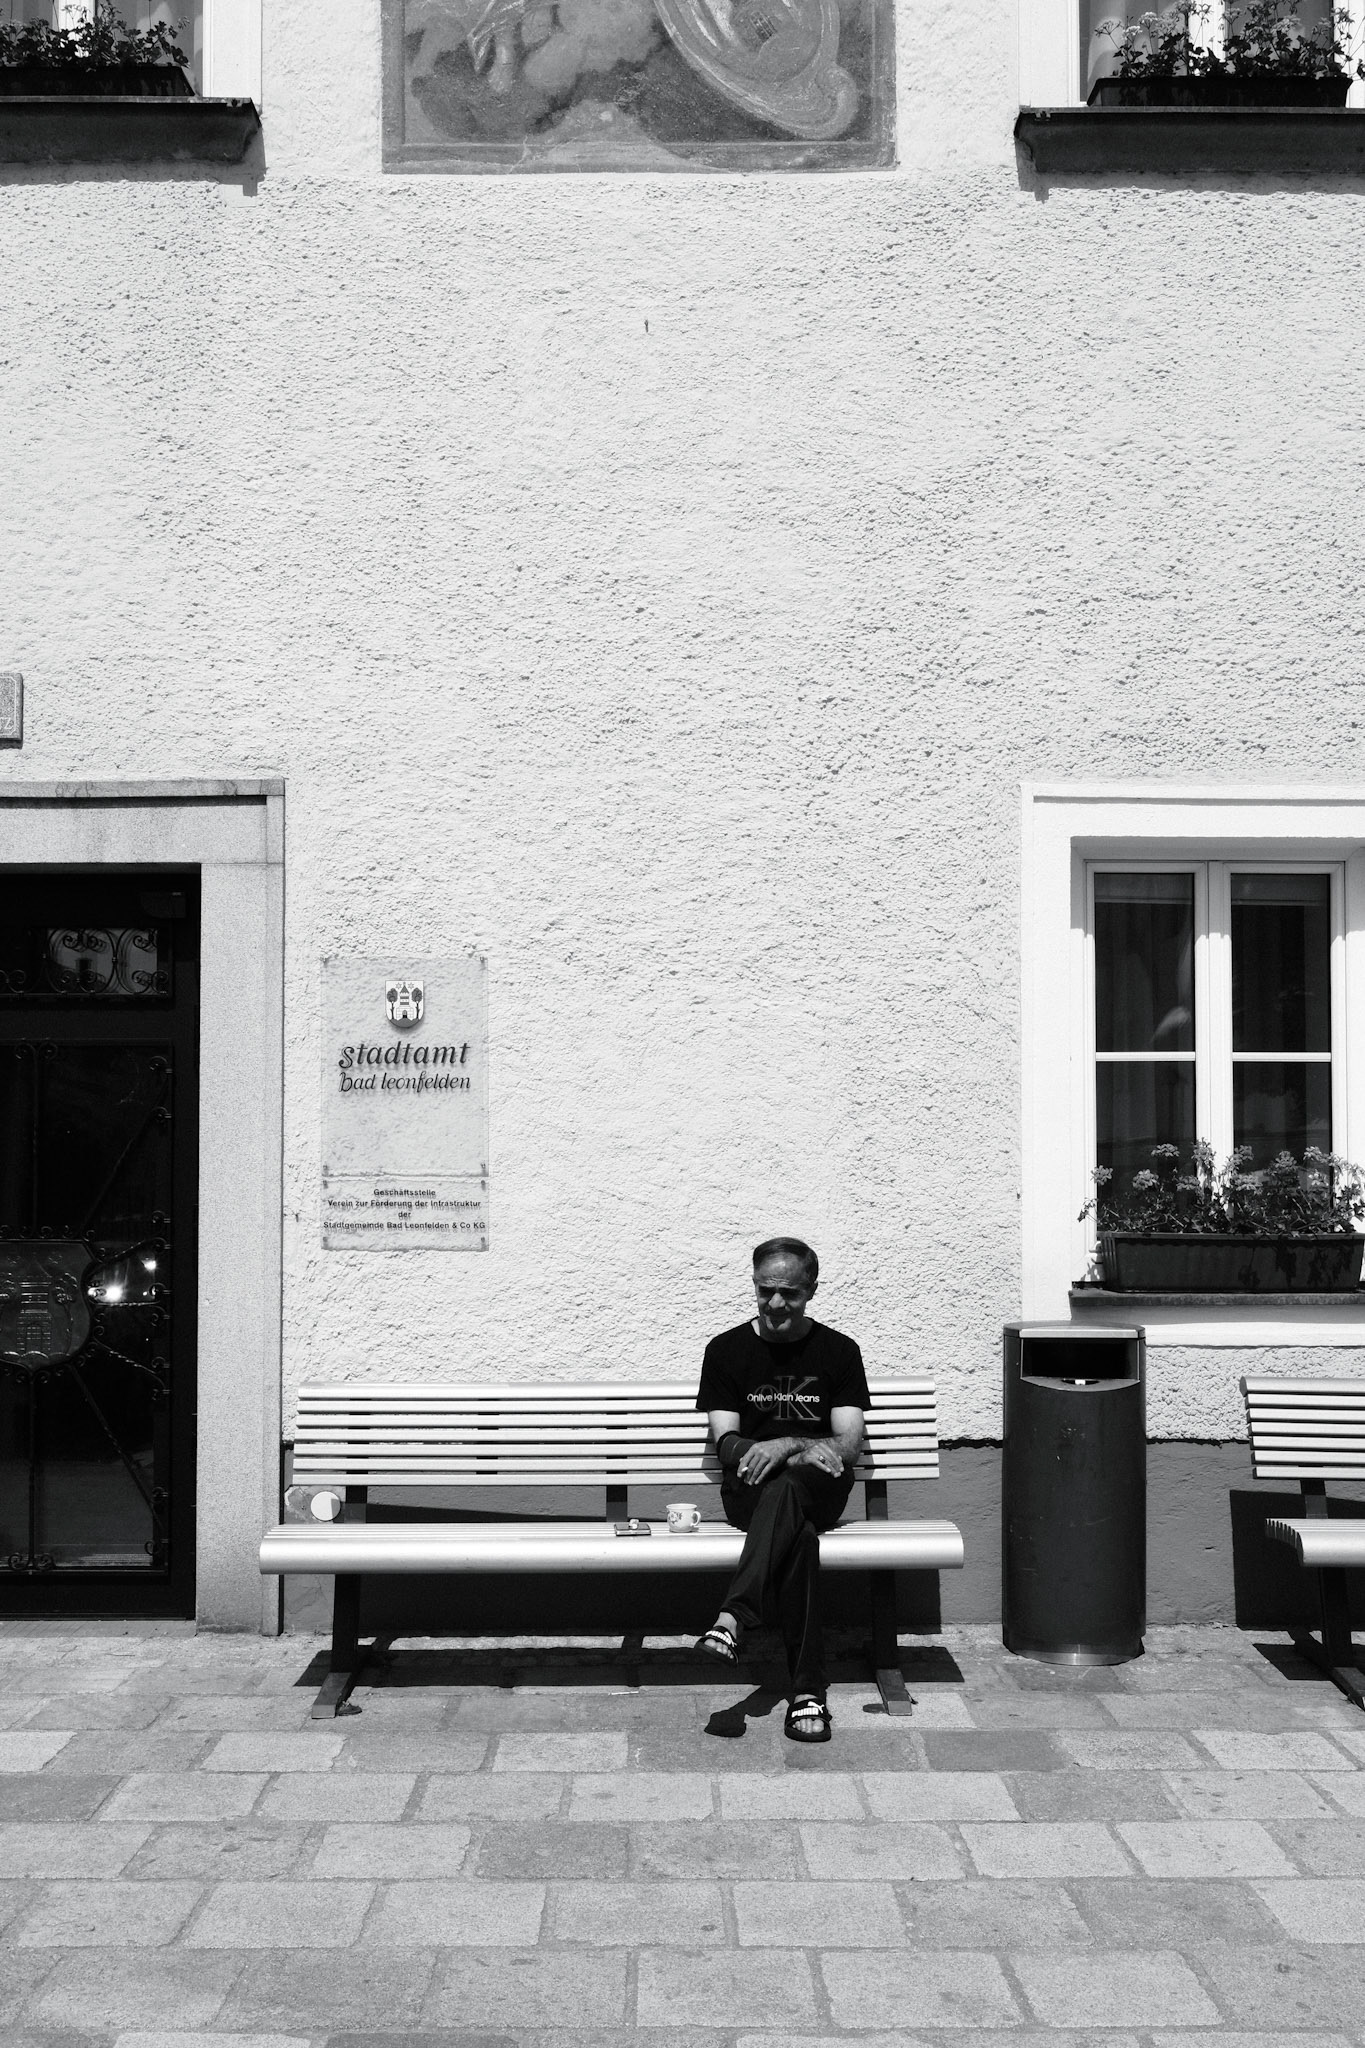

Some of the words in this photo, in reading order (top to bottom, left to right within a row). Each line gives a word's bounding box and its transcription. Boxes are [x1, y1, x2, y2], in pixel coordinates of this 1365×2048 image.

[338, 1041, 471, 1069] stadtamt
[338, 1072, 376, 1092] bad
[381, 1070, 470, 1093] leonfelden
[373, 1188, 436, 1196] Geschäftsstelle
[370, 1198, 413, 1210] Förderung
[323, 1222, 384, 1230] Stadtgemeinde
[795, 1393, 821, 1403] Jeans
[791, 1707, 819, 1718] PUMA
